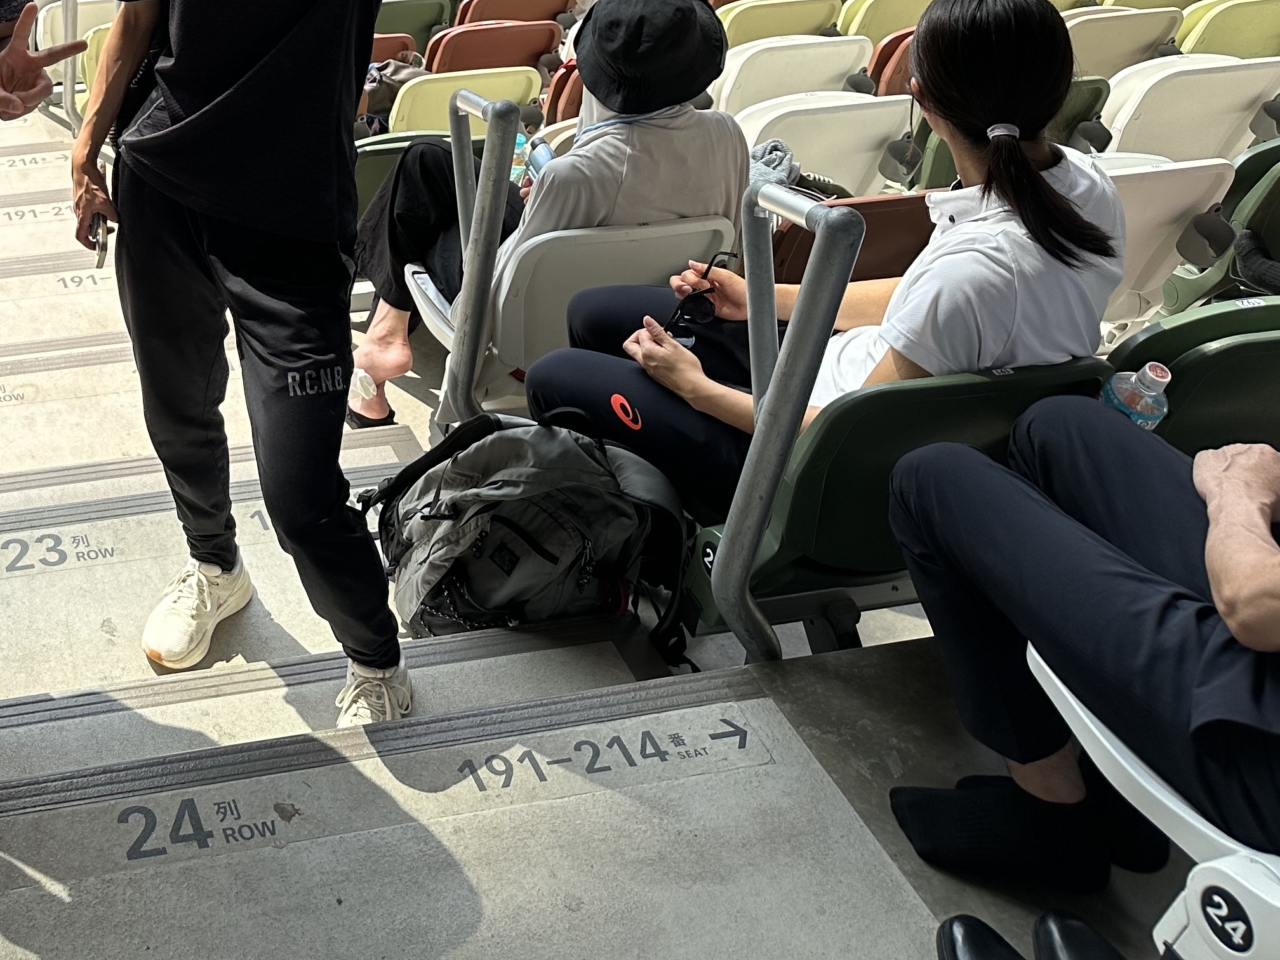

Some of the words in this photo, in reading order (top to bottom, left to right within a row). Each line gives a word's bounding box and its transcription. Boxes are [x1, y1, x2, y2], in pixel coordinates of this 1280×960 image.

[3, 206, 74, 221] 191-21
[56, 274, 112, 289] 191-
[286, 365, 347, 397] R.C.N.B.
[0, 533, 69, 572] 23
[70, 533, 90, 550] 列
[76, 546, 117, 563] ROW
[703, 547, 715, 570] 2
[457, 730, 670, 792] 191-214
[667, 732, 688, 748] 番
[677, 747, 711, 760] SEAT
[116, 797, 215, 862] 24
[214, 800, 241, 824] 列
[222, 818, 278, 844] ROW
[1206, 894, 1248, 945] 24
